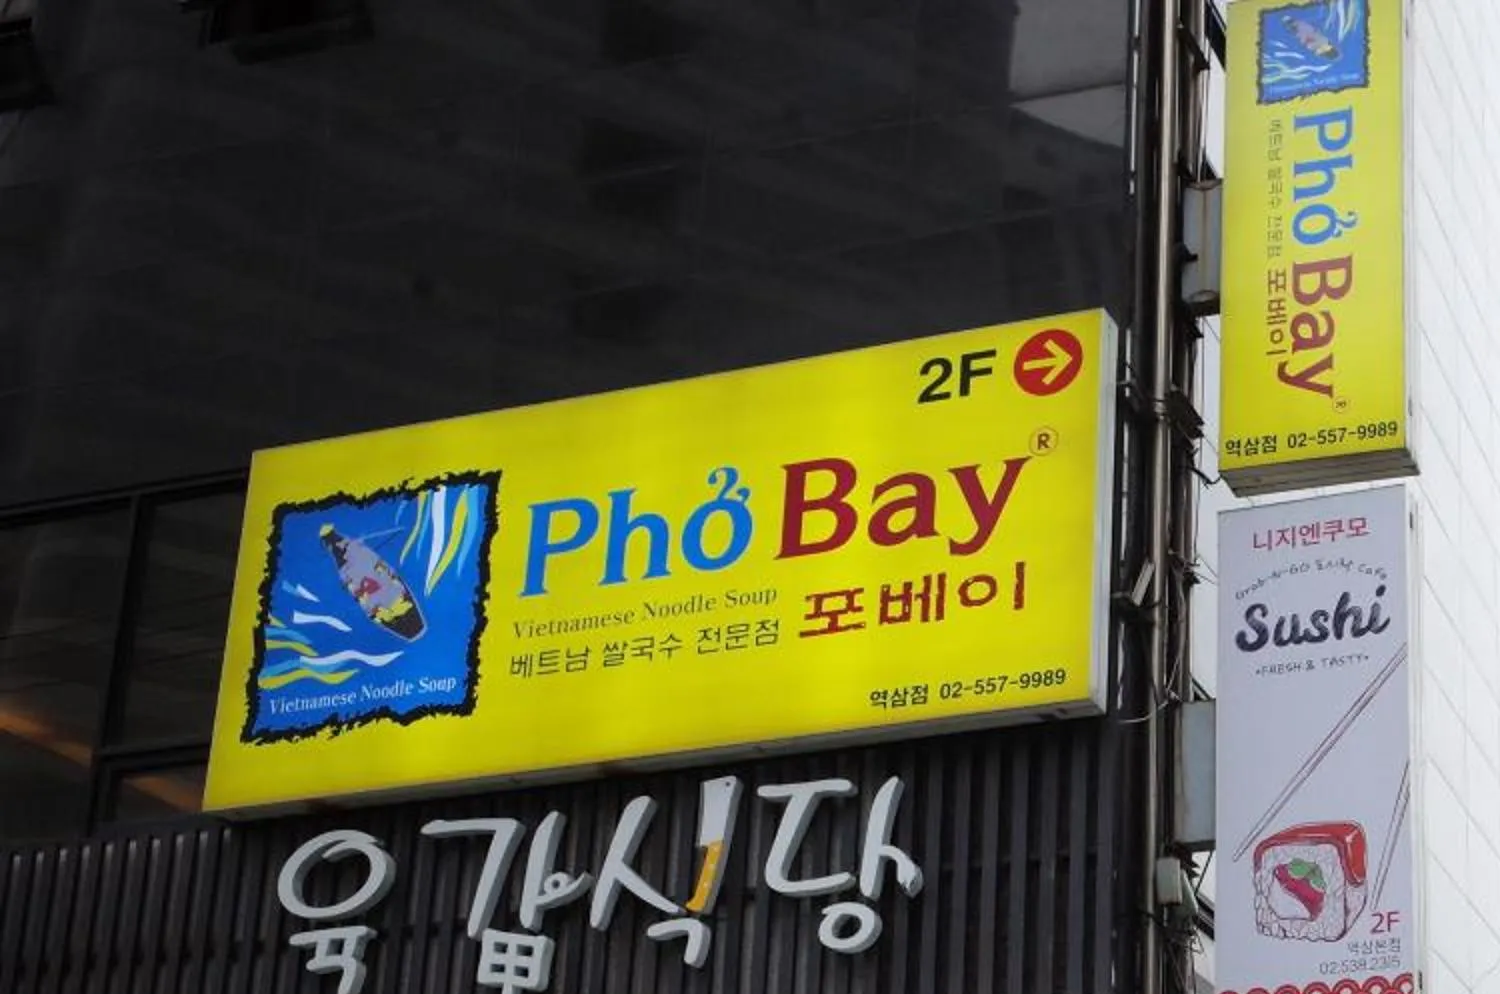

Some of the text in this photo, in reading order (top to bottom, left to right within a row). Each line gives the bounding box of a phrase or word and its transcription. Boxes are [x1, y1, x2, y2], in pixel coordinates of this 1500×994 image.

[1266, 269, 1287, 356] 포베이
[1277, 255, 1353, 399] Bay
[916, 349, 997, 404] 2F
[1225, 421, 1398, 457] 역삼점 02-557-9989
[775, 454, 1033, 560] Bay
[1252, 517, 1371, 552] 니지엔쿠모
[509, 561, 1027, 680] 베트남 쌀국수 전문점 포베이
[511, 584, 779, 641] Vietnamese Noodle Soup
[1235, 584, 1391, 652] Sushi
[268, 676, 458, 717] Vietnamese Noodle Soup
[869, 669, 1067, 712] 역삼점 02-557-9989
[1370, 911, 1401, 935] 2F
